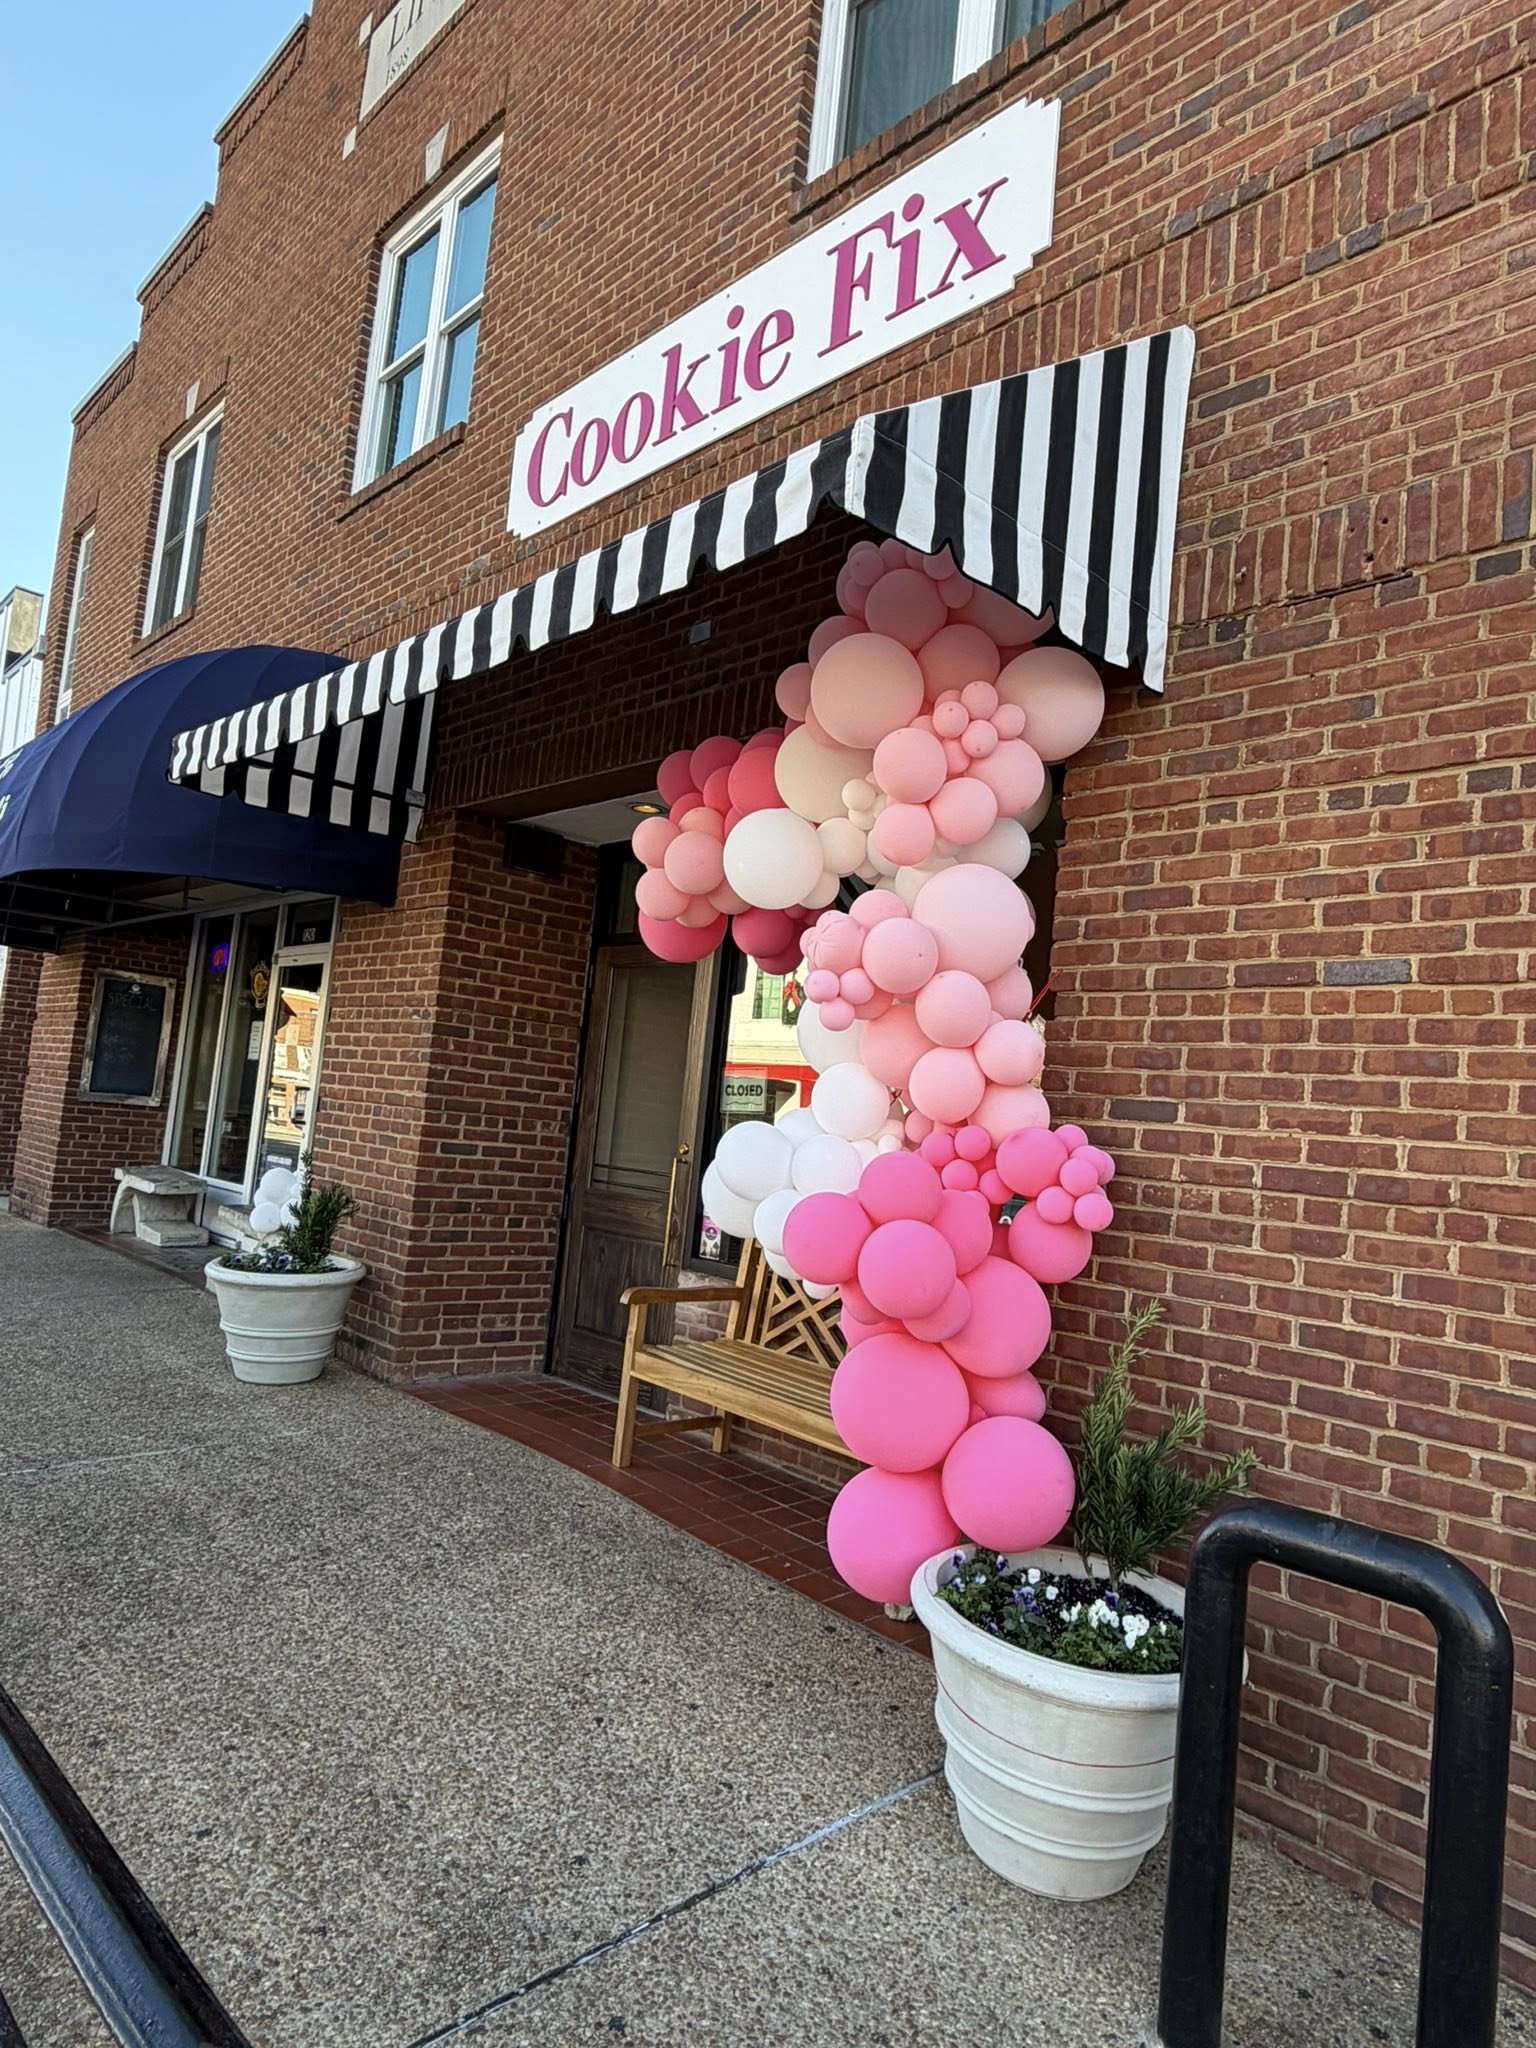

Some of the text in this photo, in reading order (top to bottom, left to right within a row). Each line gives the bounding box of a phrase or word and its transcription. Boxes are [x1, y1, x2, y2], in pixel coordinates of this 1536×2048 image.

[527, 176, 1009, 507] Cookie Fix
[725, 1084, 763, 1097] CLOSED
